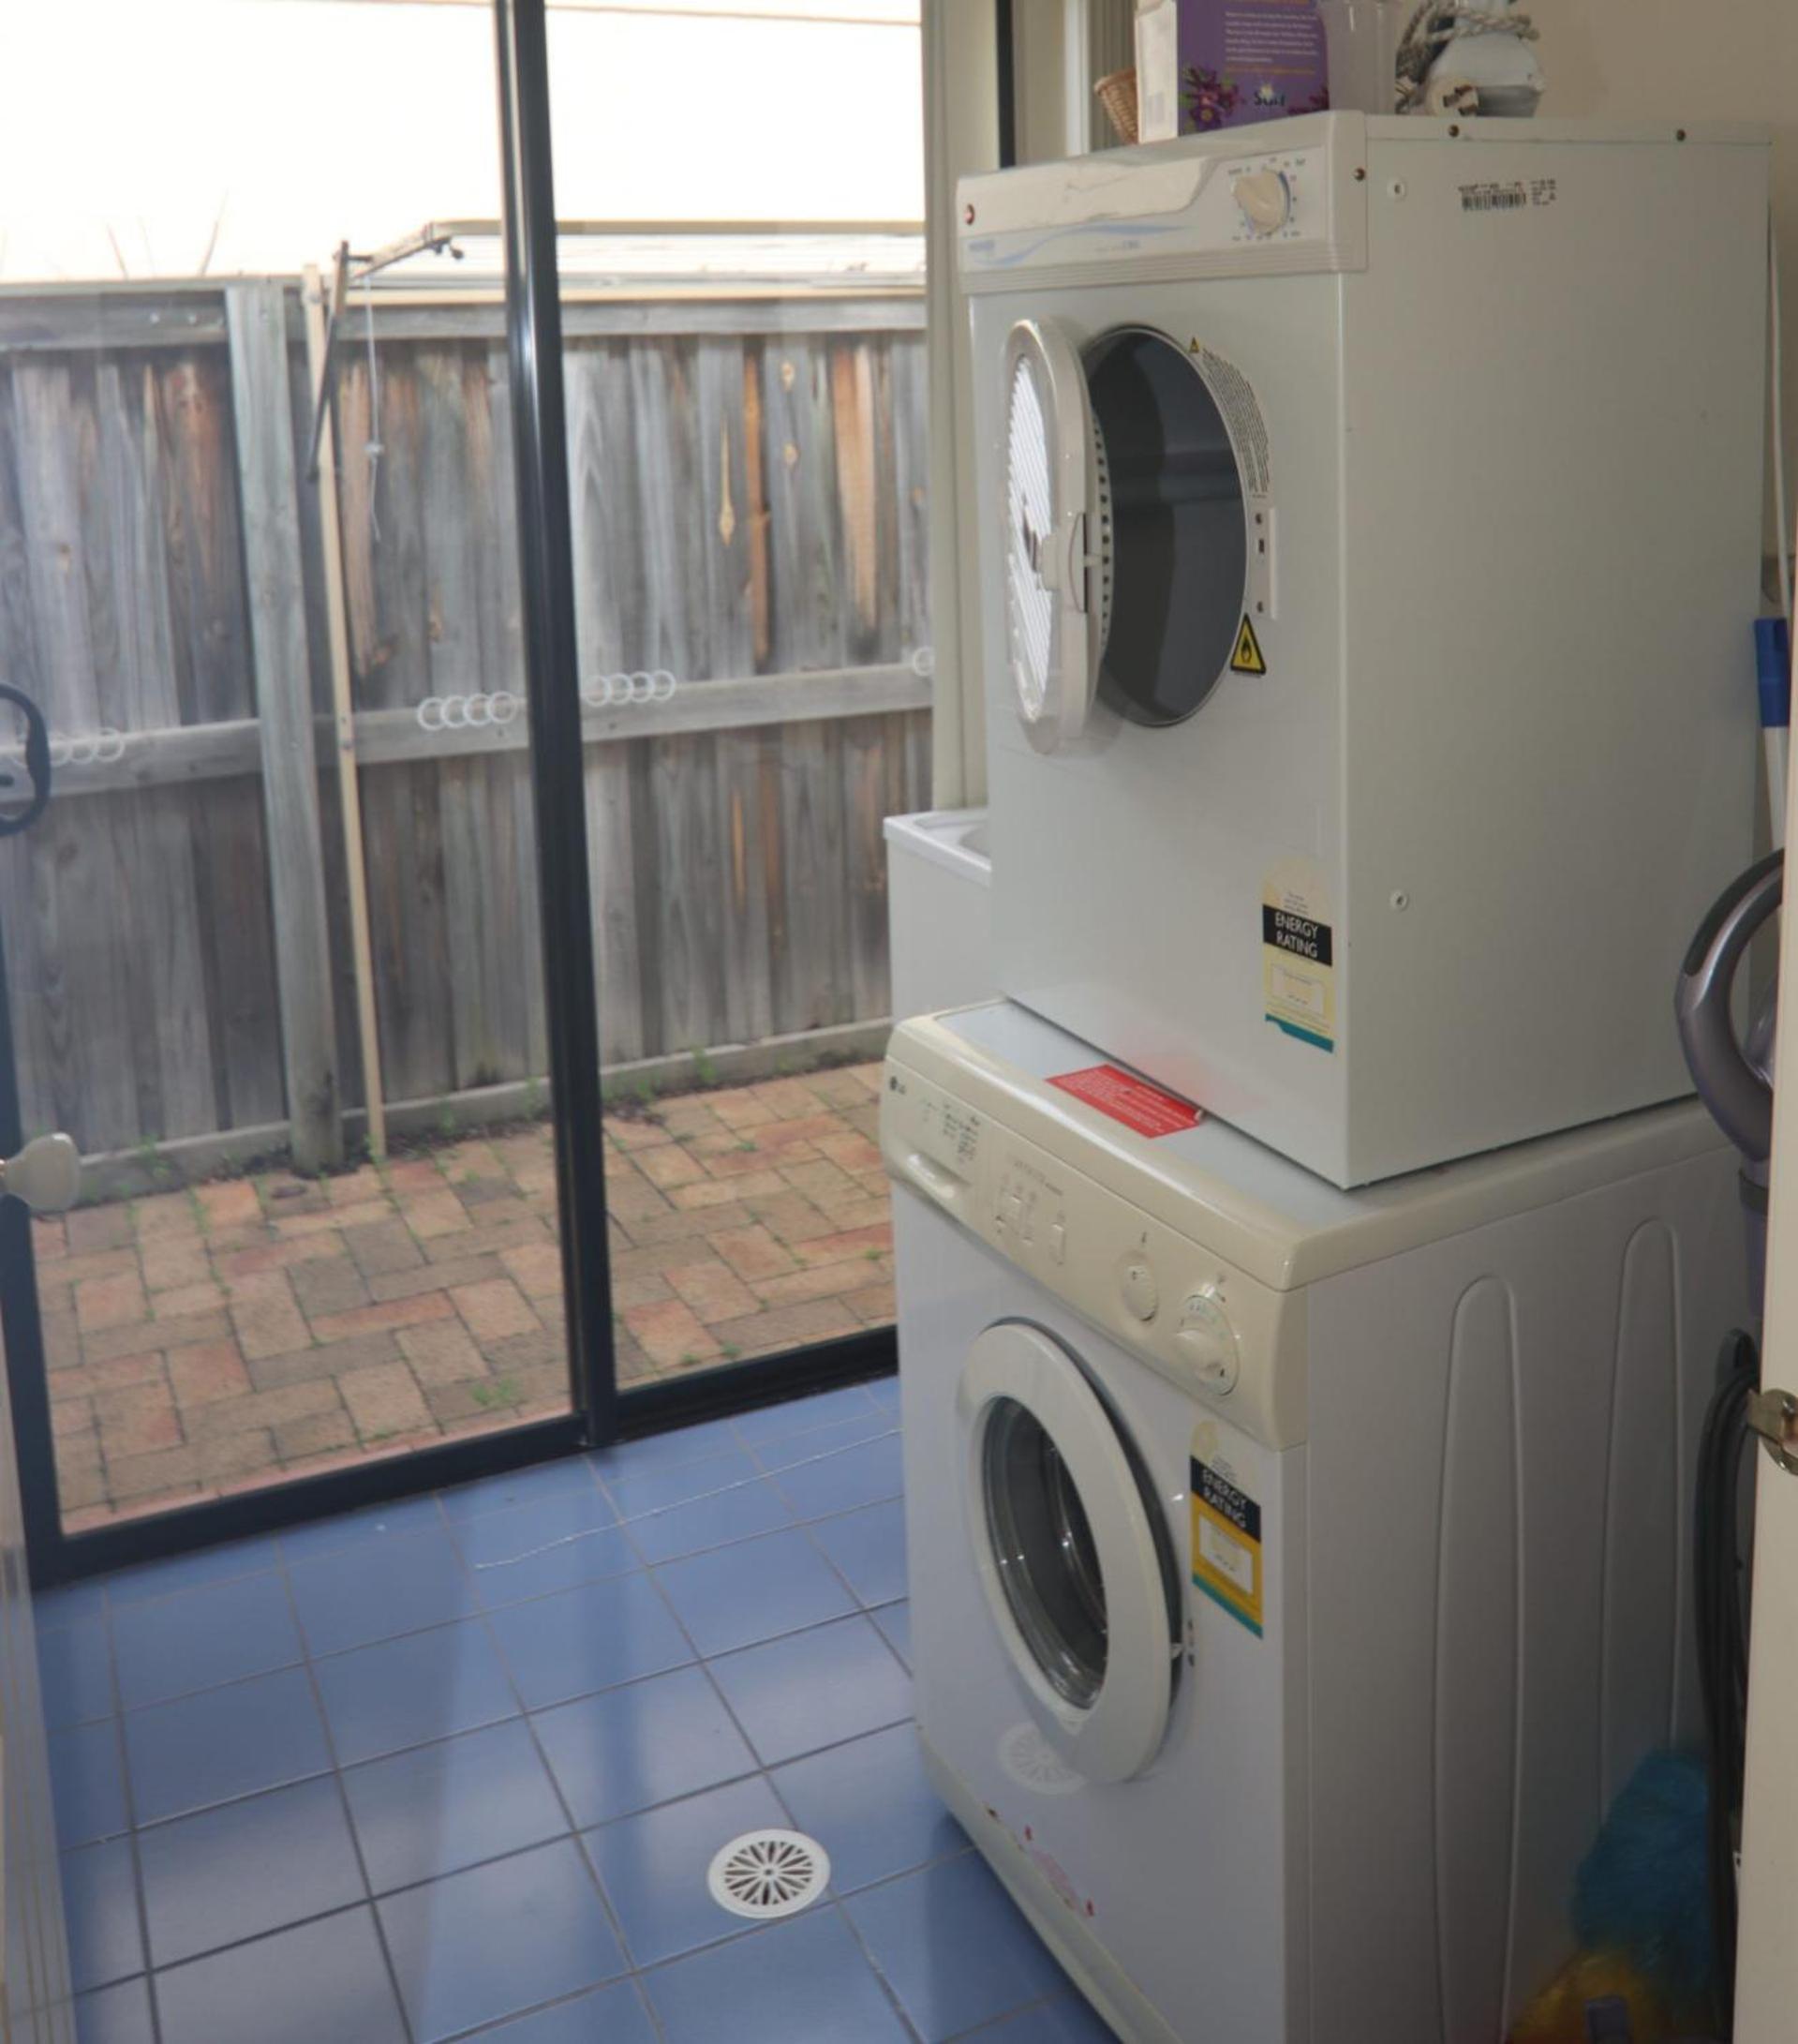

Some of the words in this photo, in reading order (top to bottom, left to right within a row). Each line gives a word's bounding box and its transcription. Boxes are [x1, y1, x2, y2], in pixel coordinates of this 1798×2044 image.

[1274, 911, 1318, 939] ENERGY
[1276, 930, 1318, 958] RATING
[1202, 1469, 1246, 1509] ENERGY
